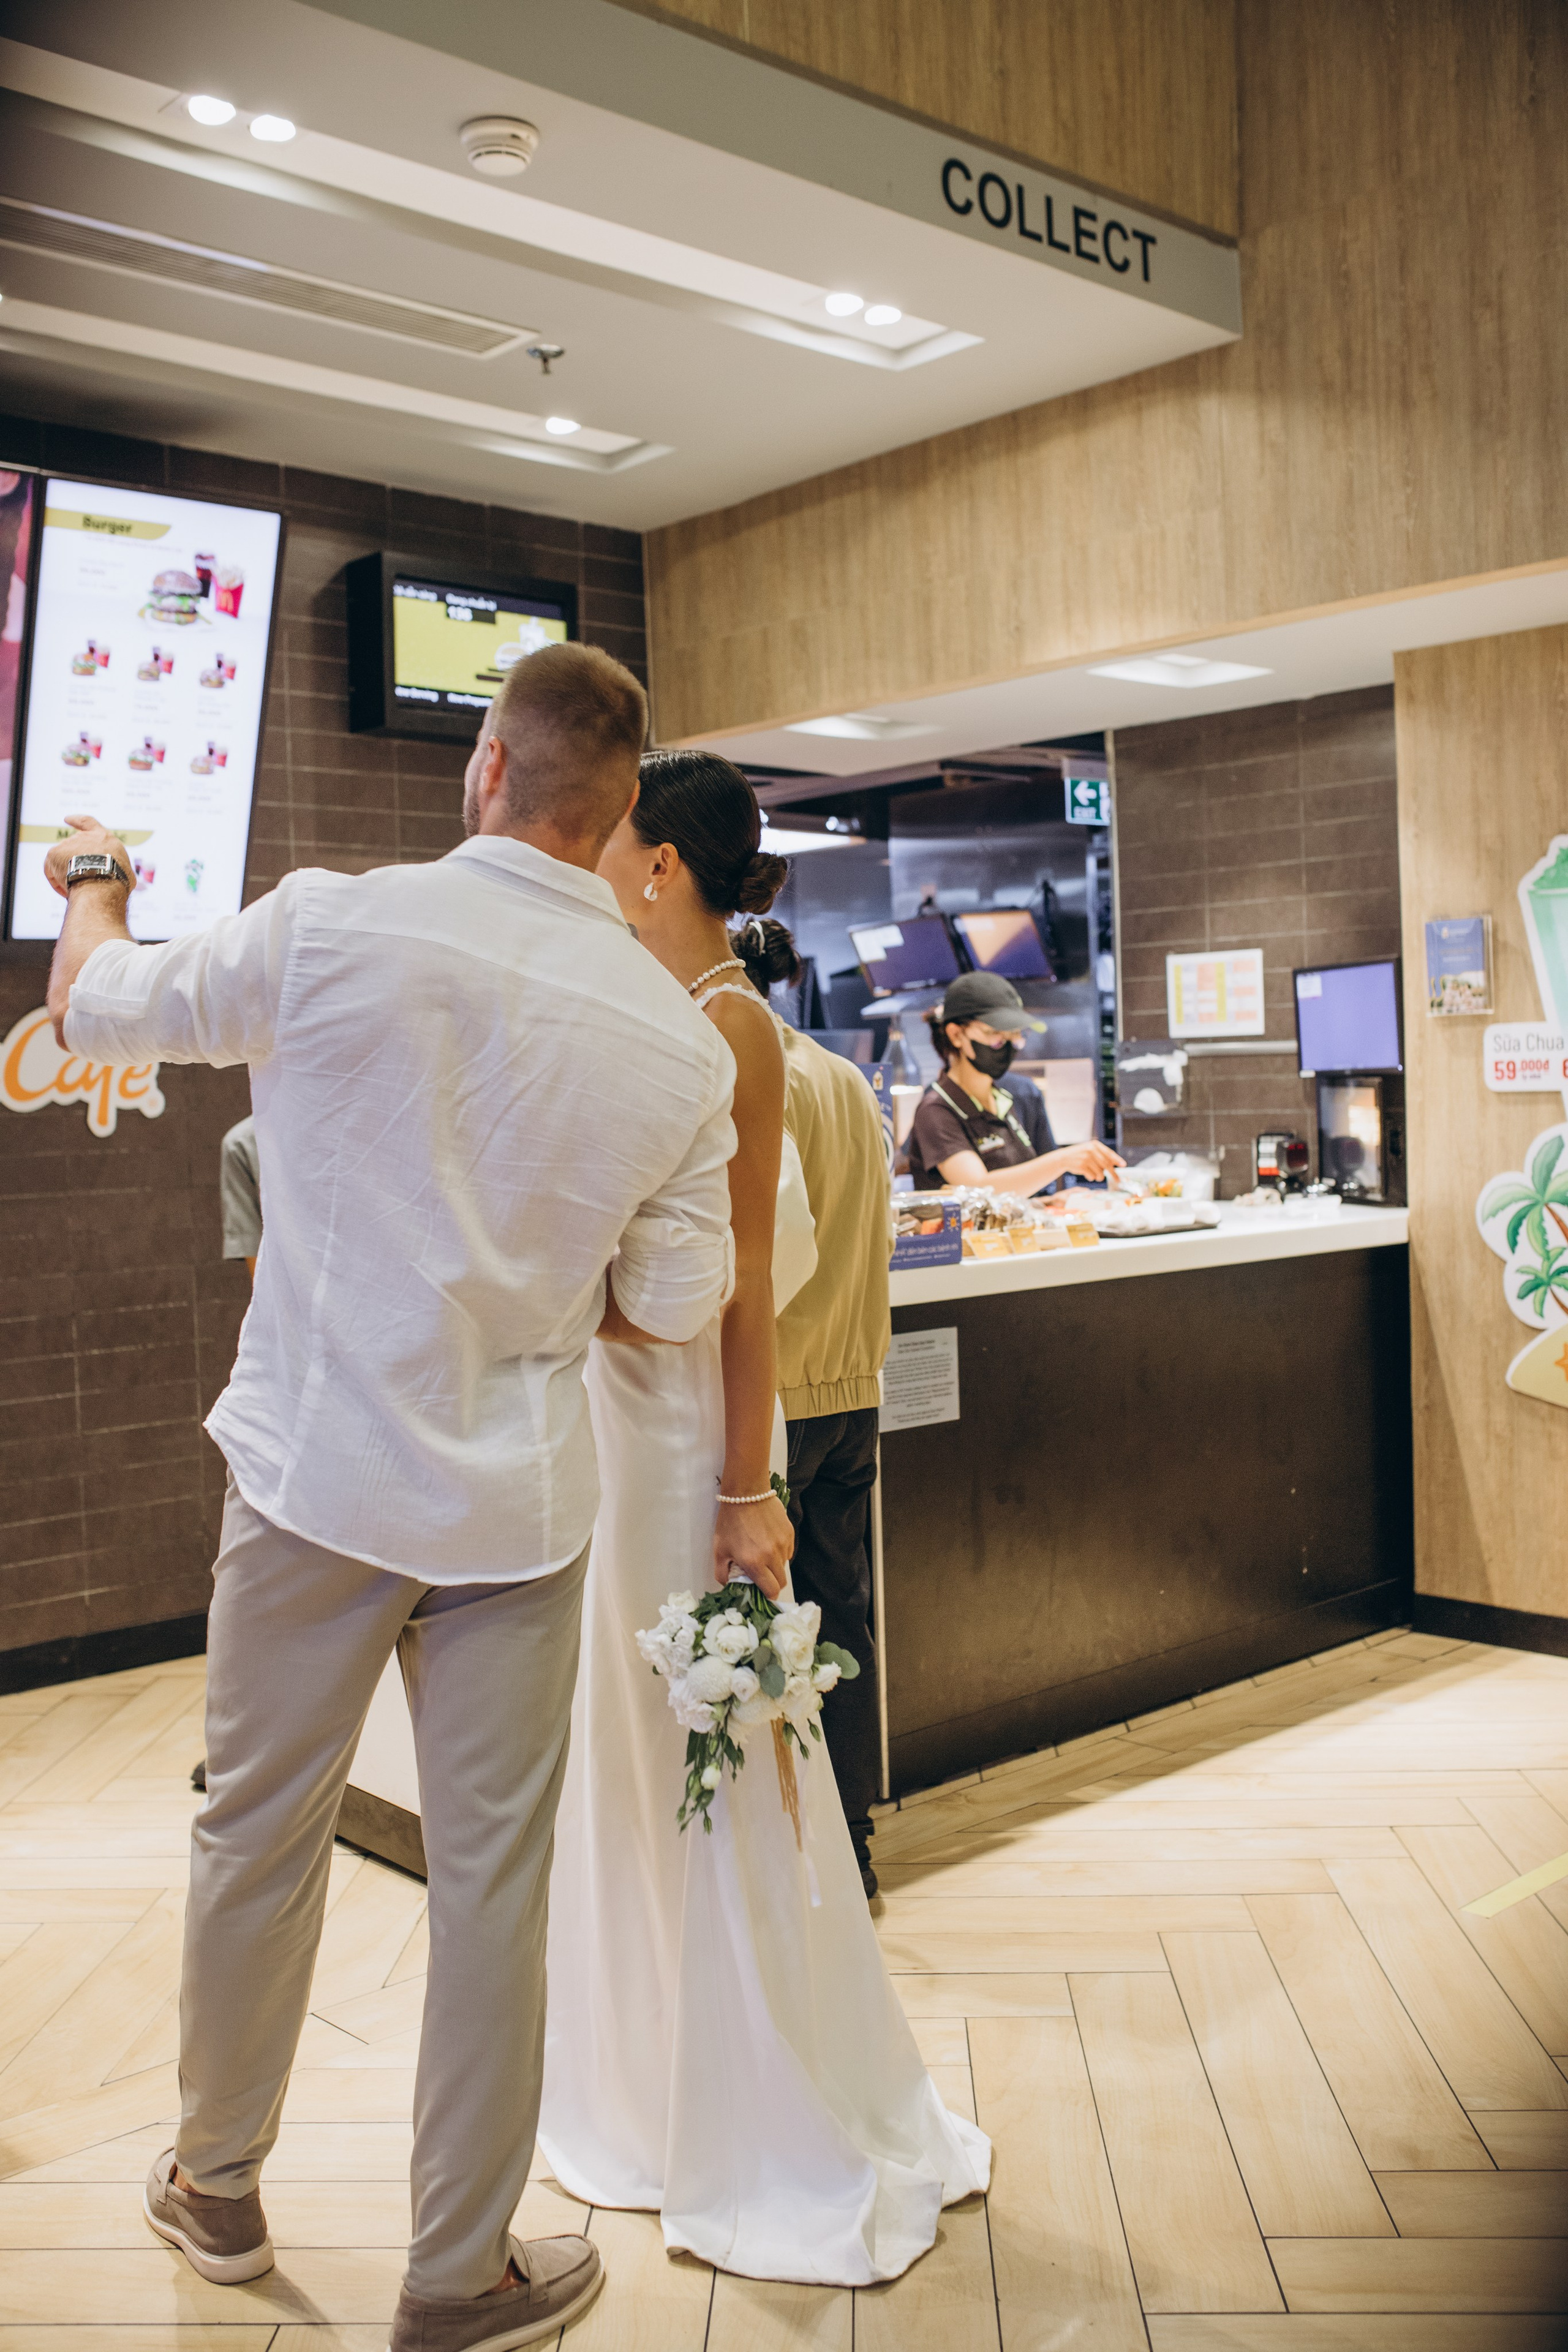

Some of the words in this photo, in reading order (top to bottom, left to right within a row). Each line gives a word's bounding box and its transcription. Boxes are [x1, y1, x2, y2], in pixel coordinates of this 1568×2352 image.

[941, 158, 1157, 282] COLLECT
[83, 514, 132, 534] Burger
[1526, 1033, 1564, 1051] Chua
